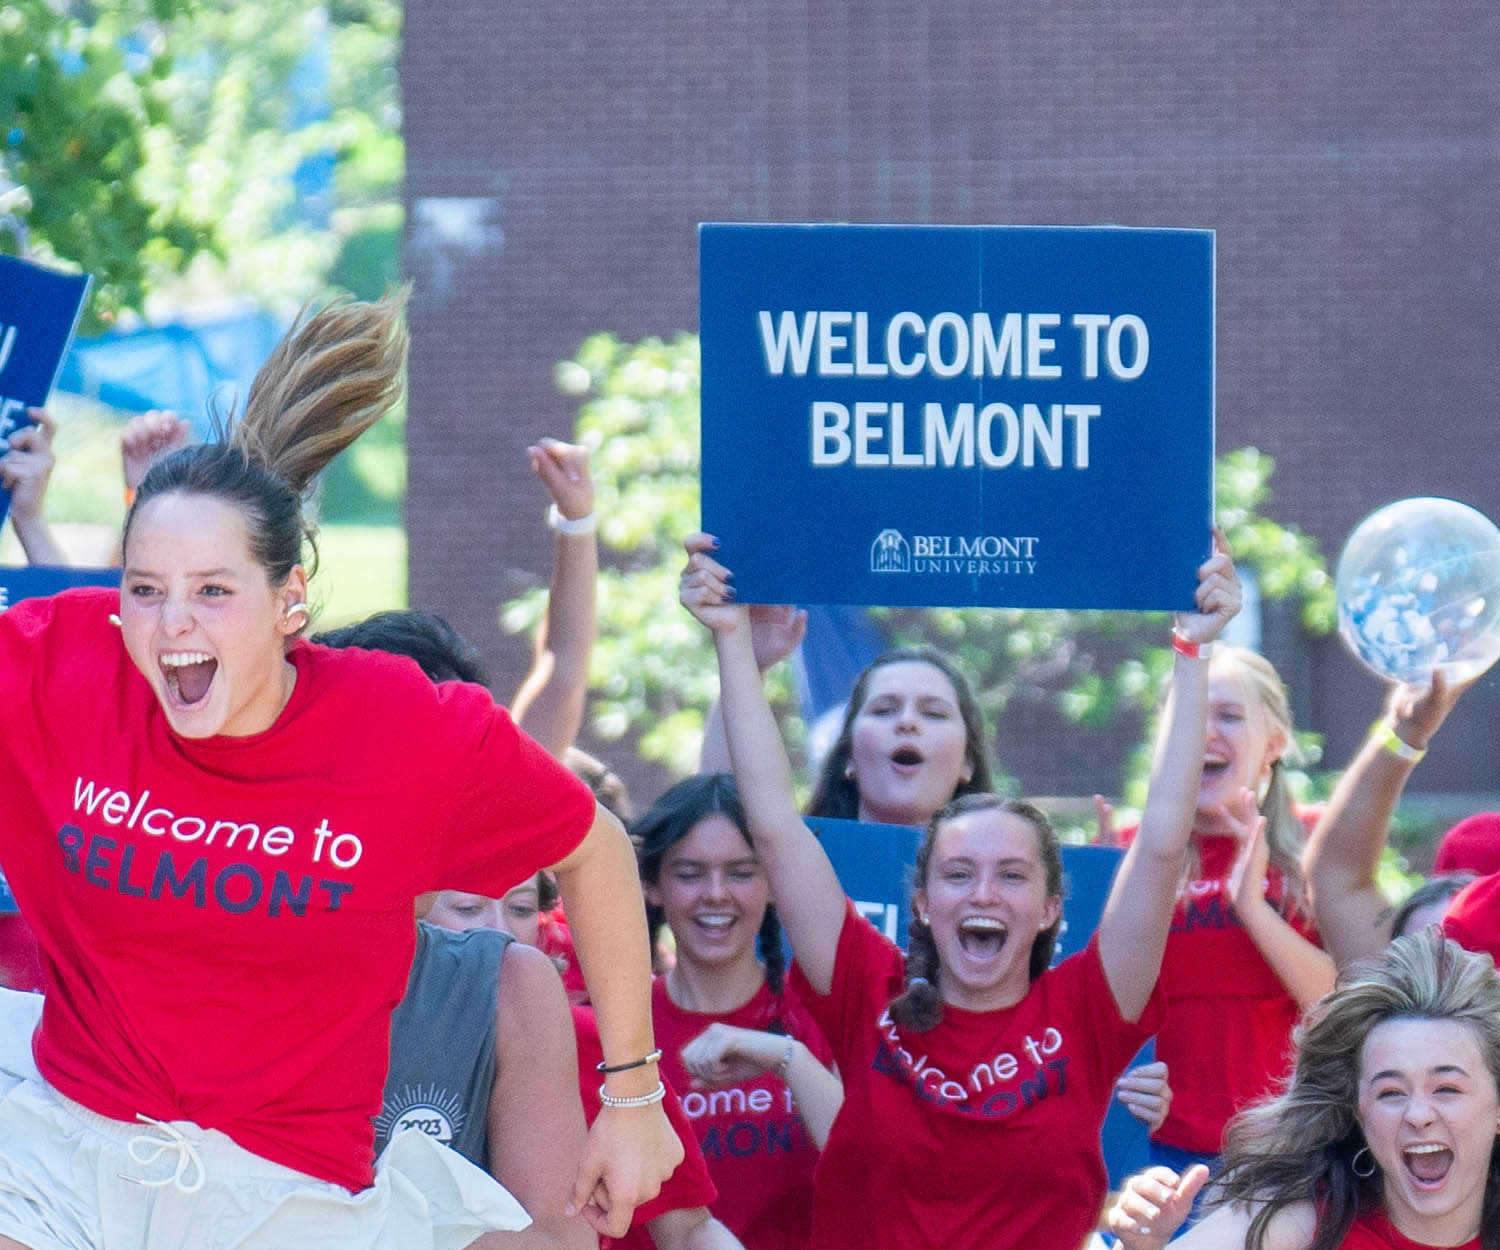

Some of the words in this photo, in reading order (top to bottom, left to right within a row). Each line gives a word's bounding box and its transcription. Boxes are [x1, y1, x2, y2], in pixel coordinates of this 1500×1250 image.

[759, 310, 1063, 378] WELCOME
[1073, 313, 1150, 379] TO
[812, 400, 1102, 470] BELMONT
[913, 535, 1039, 559] BELMONT
[913, 560, 1038, 575] UNIVERSITY
[73, 776, 295, 855] welcome
[312, 818, 363, 868] to
[57, 822, 355, 918] BELMONT
[1024, 1026, 1063, 1065] to
[701, 1115, 809, 1162] MONT
